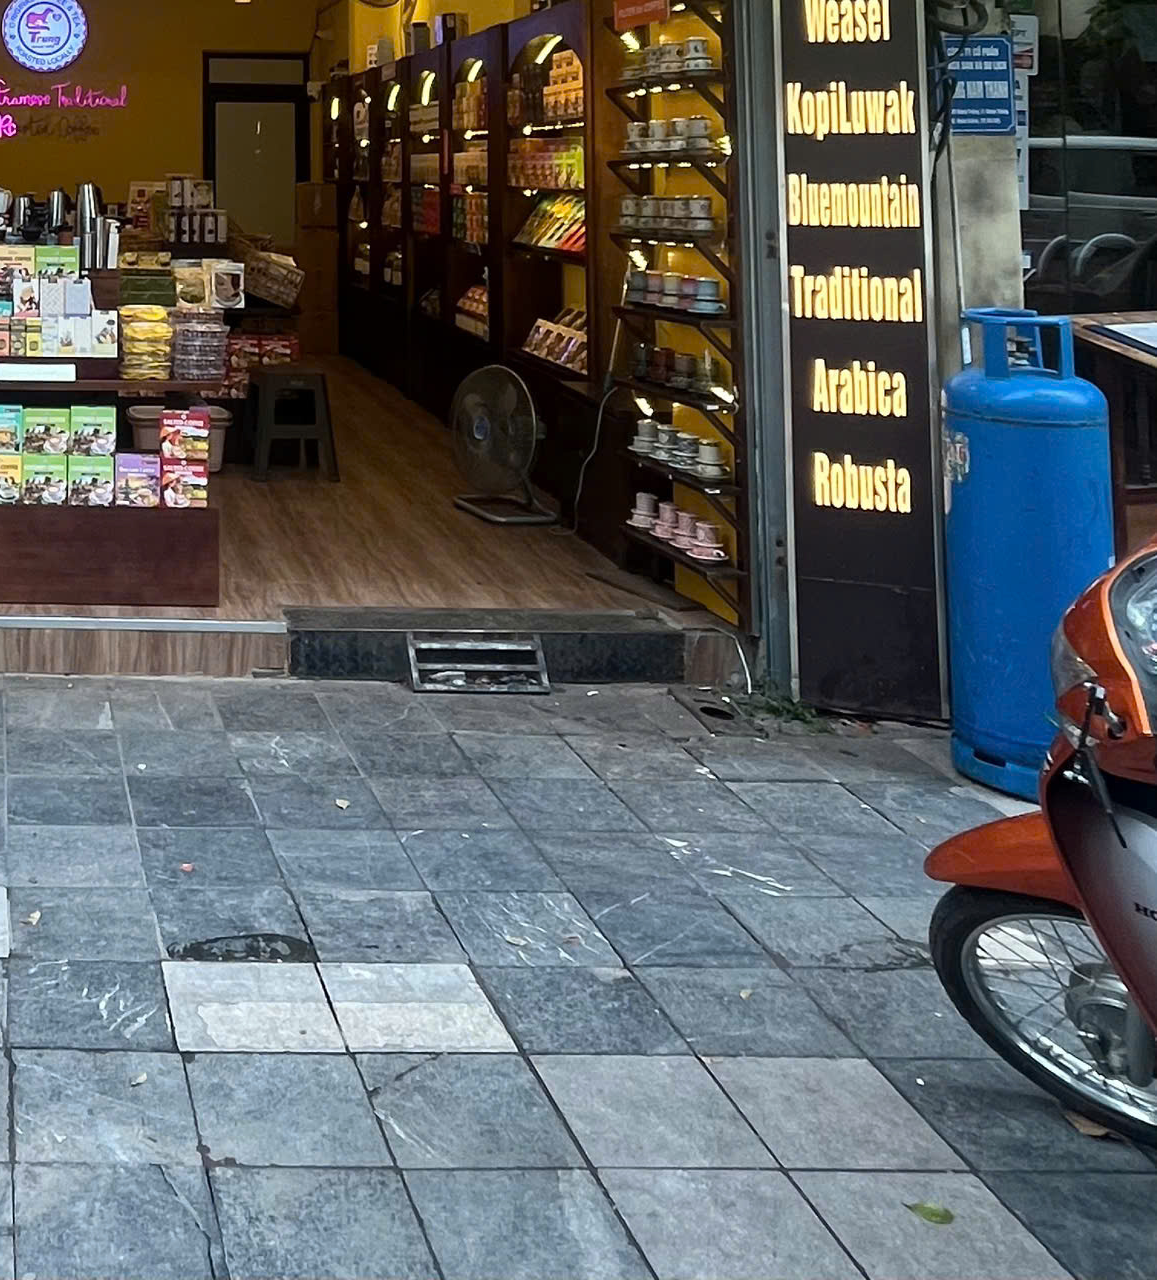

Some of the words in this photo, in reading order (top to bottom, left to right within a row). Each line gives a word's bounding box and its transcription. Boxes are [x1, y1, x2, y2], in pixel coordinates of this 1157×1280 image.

[786, 80, 916, 141] KopiLuwak
[788, 174, 920, 228] Bluemountain
[791, 265, 923, 323] Traditional
[812, 358, 907, 417] Arabica
[812, 452, 911, 513] Robusta
